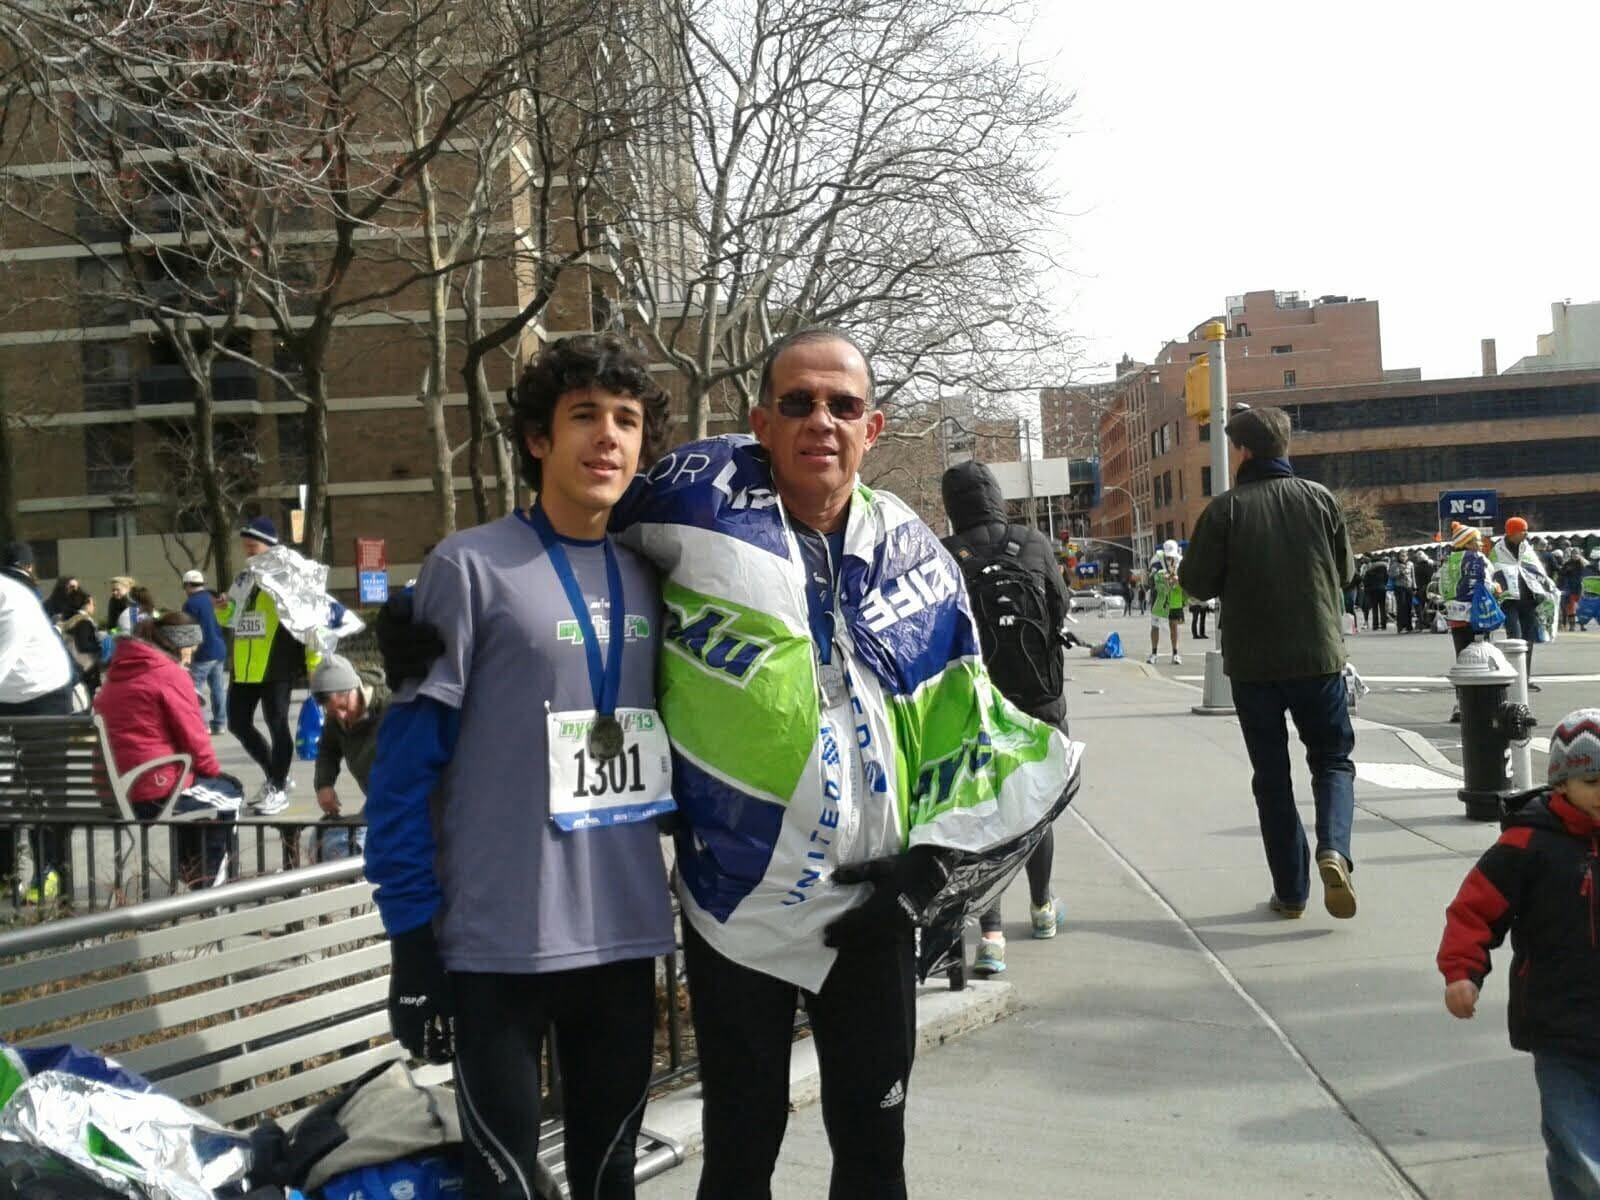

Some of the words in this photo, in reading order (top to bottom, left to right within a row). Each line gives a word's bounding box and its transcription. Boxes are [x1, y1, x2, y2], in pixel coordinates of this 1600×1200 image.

[634, 453, 710, 484] OR
[1449, 499, 1486, 514] N-Q
[859, 557, 958, 632] LIFE
[573, 743, 646, 798] 1301
[781, 780, 841, 906] UNITED
